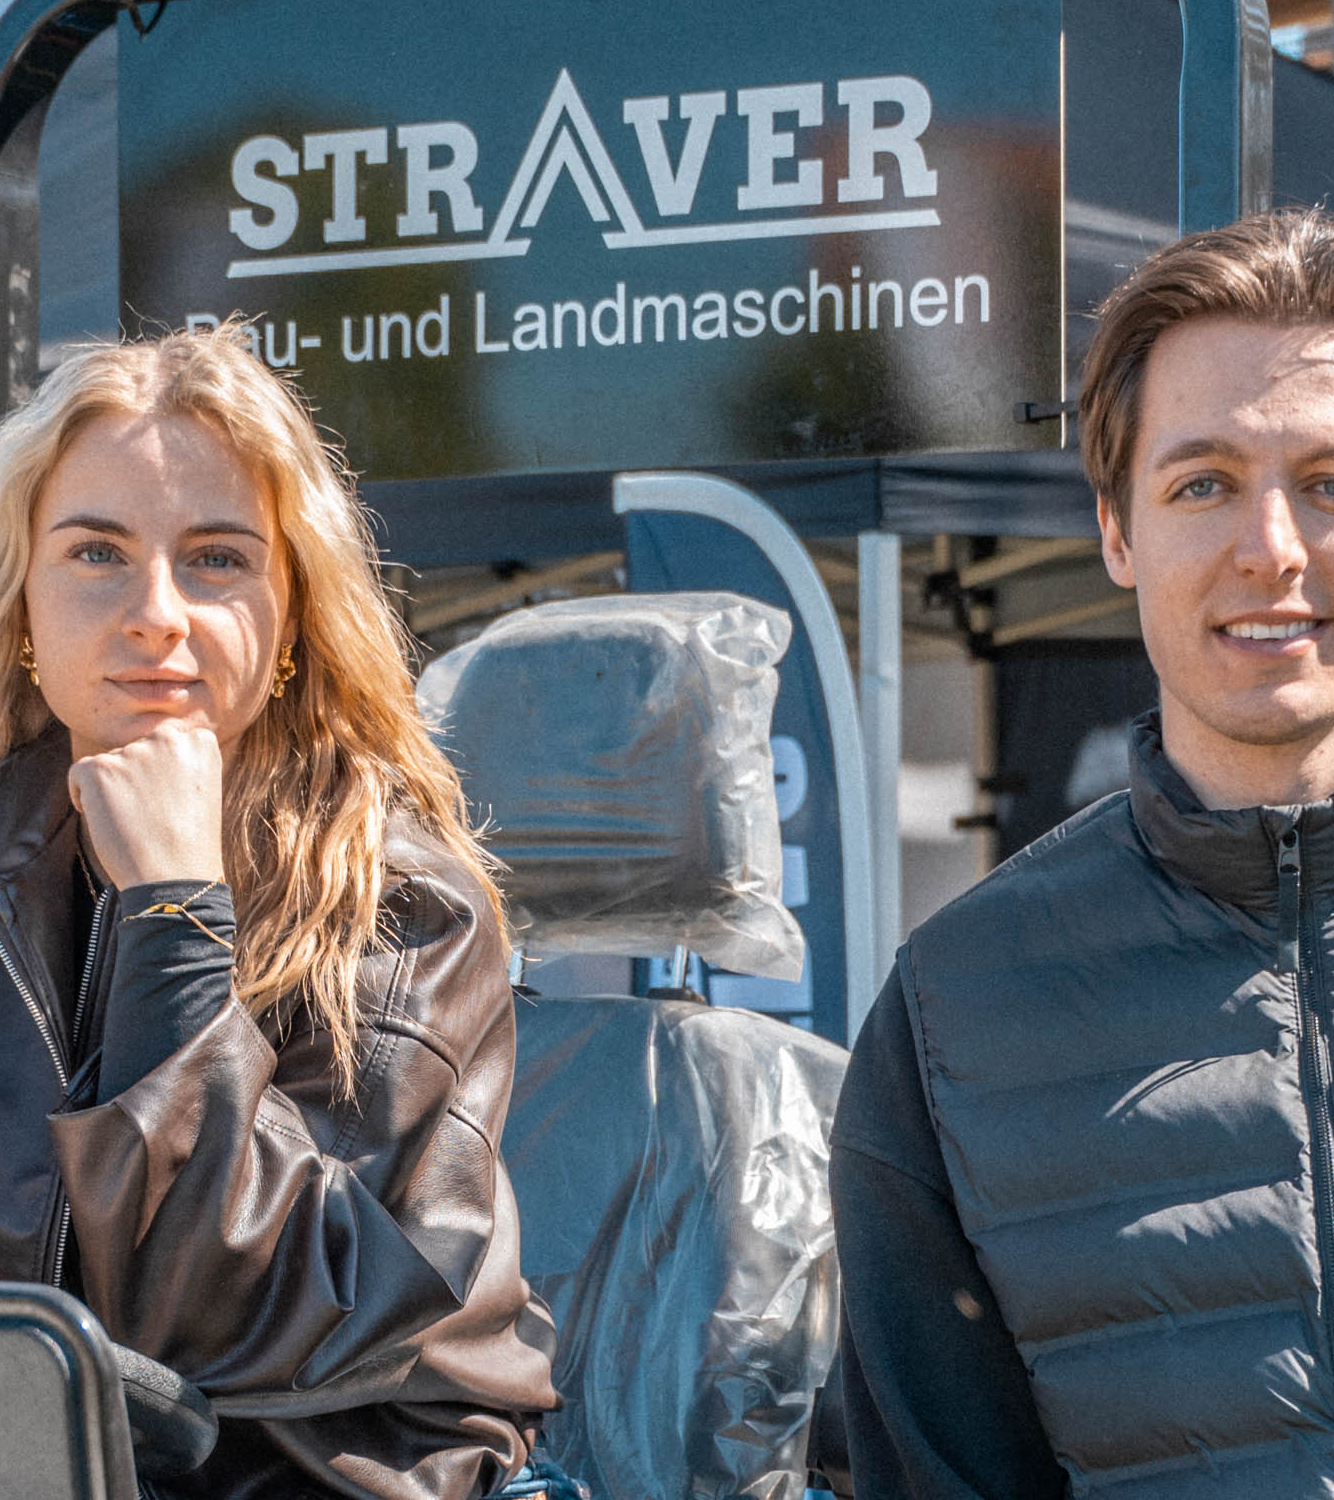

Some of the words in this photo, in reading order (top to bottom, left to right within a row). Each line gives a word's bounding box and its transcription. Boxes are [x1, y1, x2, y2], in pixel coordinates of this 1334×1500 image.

[228, 67, 940, 260] STRAVER
[342, 293, 451, 363] und
[474, 269, 992, 356] Landmaschinen
